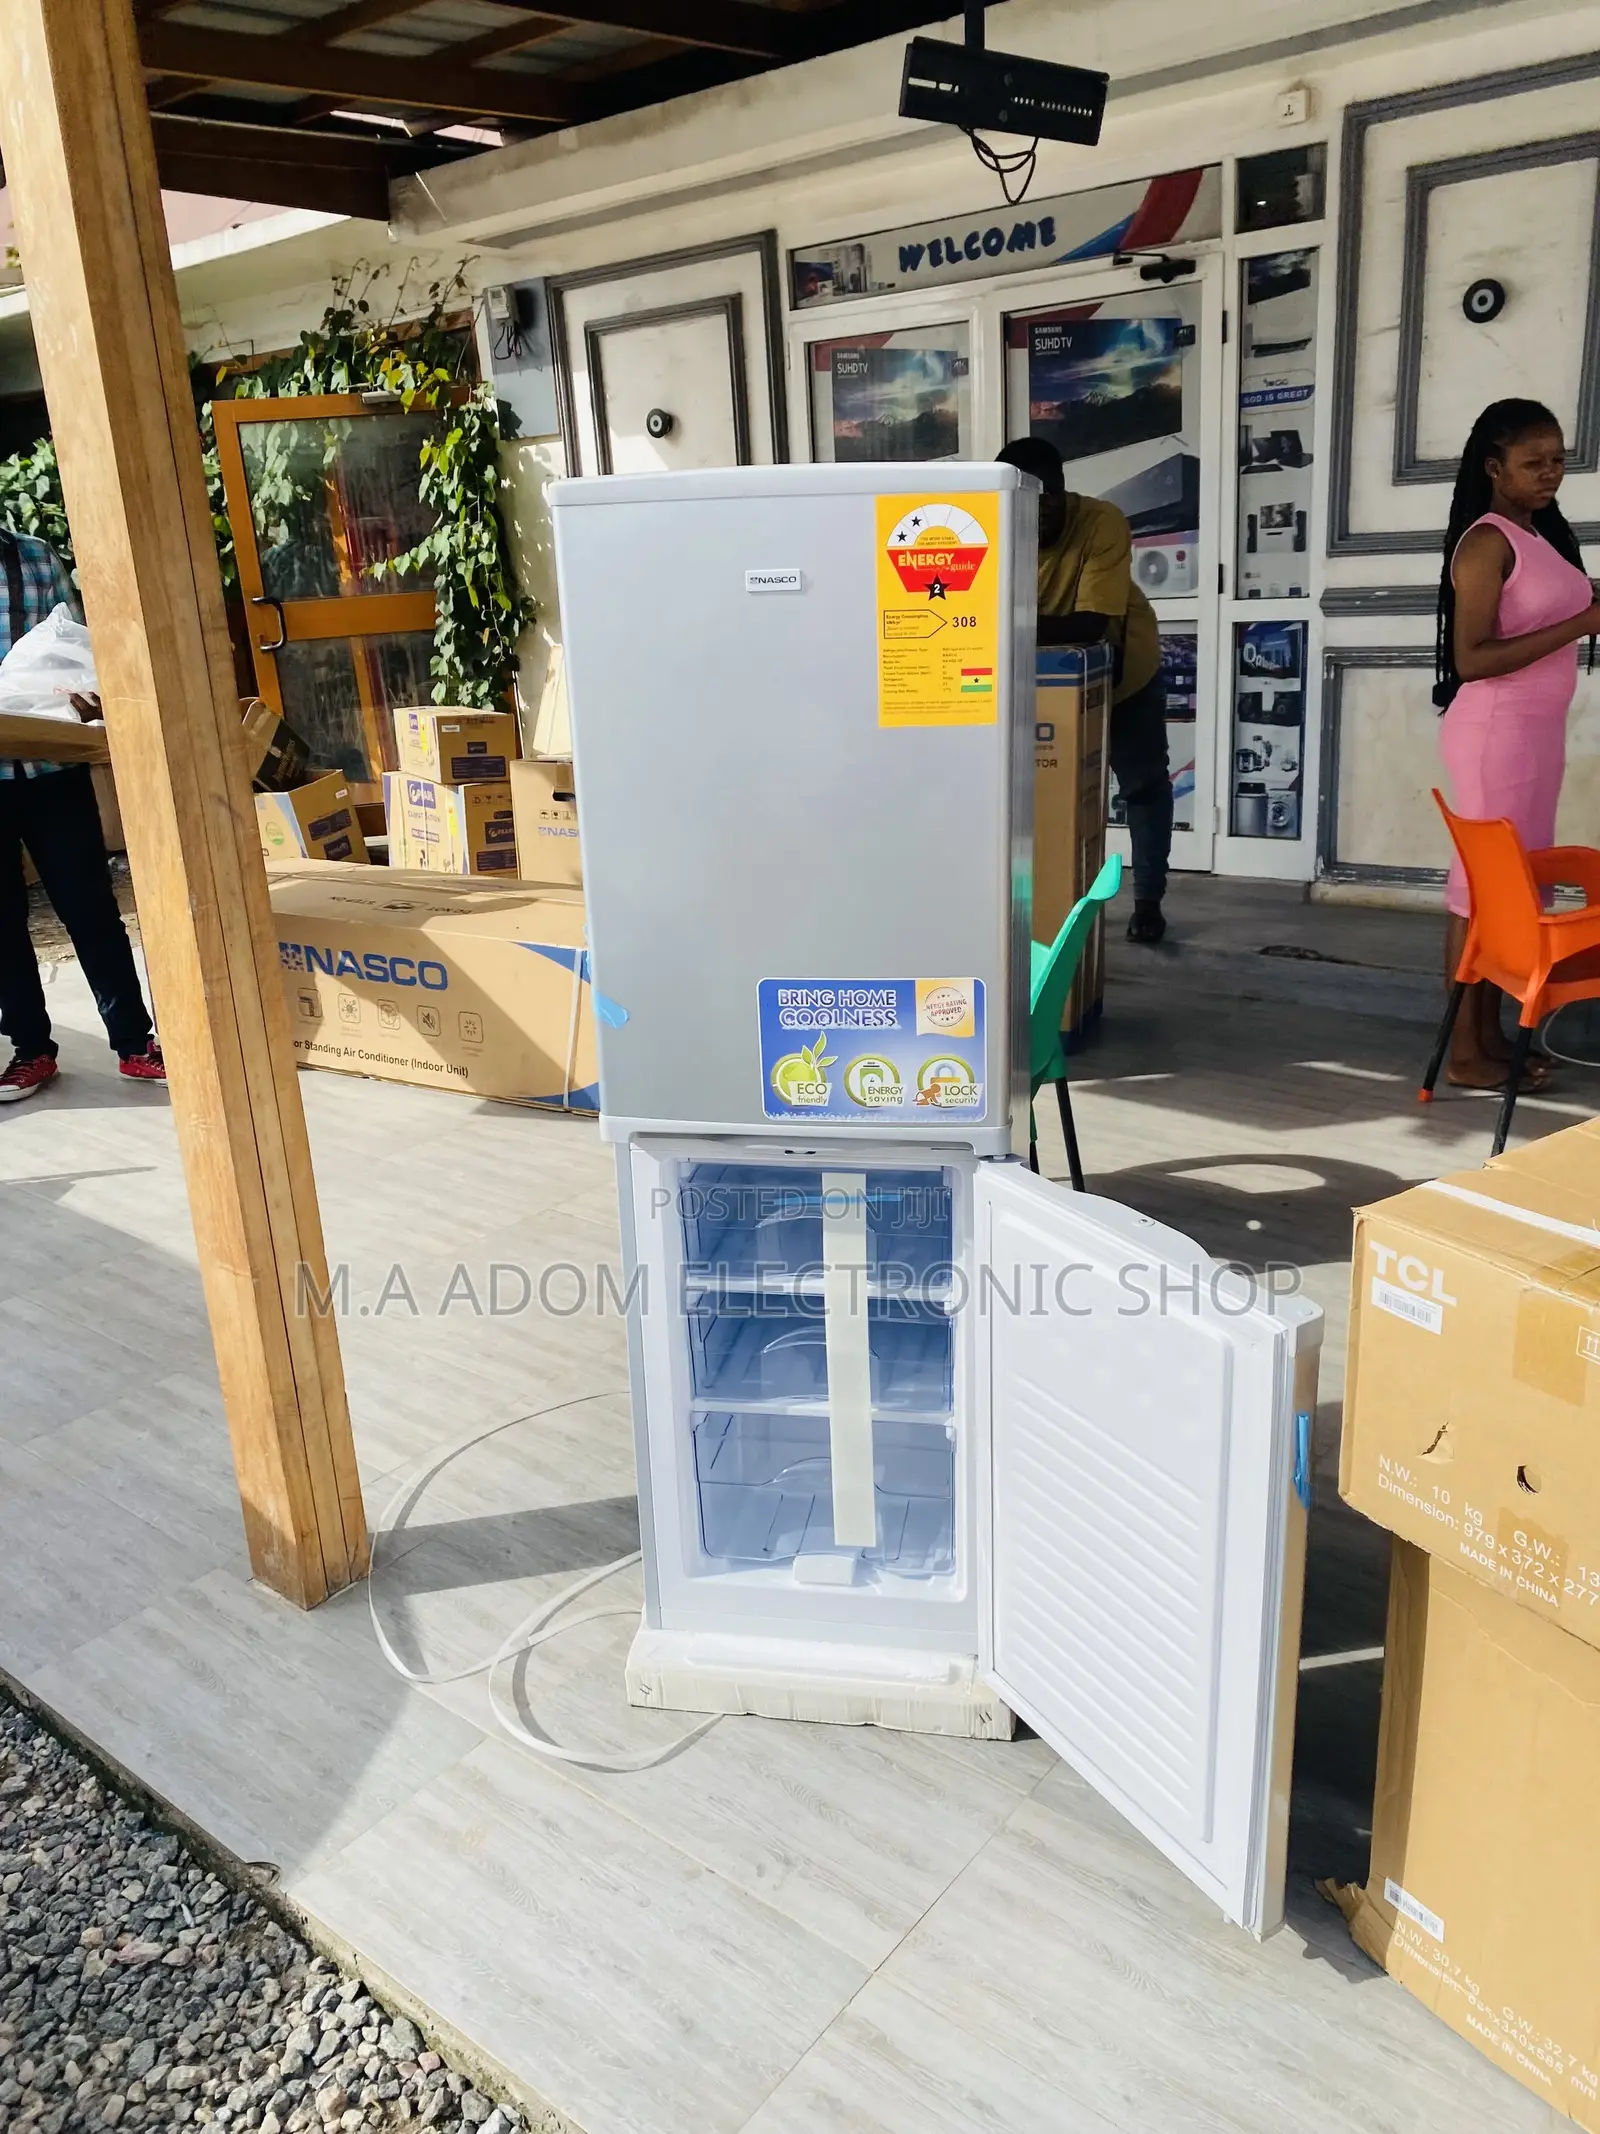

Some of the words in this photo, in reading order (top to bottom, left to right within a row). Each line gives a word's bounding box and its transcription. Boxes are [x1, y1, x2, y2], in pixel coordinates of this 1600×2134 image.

[898, 216, 1056, 272] WELCOME
[898, 550, 954, 571] ENERGY
[950, 560, 976, 572] guide
[758, 576, 797, 584] NASCO
[933, 584, 941, 594] 2
[952, 616, 977, 628] 308
[303, 945, 449, 991] NASCO
[778, 989, 835, 1007] BRING
[839, 989, 897, 1007] HOME
[780, 1008, 898, 1028] COOLNESS
[931, 1006, 962, 1017] APPROVED
[304, 1039, 342, 1058] Standing
[343, 1048, 356, 1058] Air
[358, 1049, 409, 1067] Conditioner
[411, 1057, 444, 1073] (Indoor
[446, 1063, 469, 1079] Unit)
[797, 1083, 827, 1095] ECO
[867, 1086, 903, 1095] ENERGY
[944, 1085, 978, 1096] LOCK
[797, 1096, 827, 1105] friendly
[868, 1095, 903, 1105] saving
[945, 1096, 978, 1105] security
[1369, 1240, 1457, 1308] TCL
[1379, 1454, 1418, 1488] N.W.:
[1432, 1485, 1451, 1505] 10
[1464, 1502, 1483, 1526] kg
[1513, 1530, 1560, 1567] G.W.:
[1378, 1473, 1459, 1531] Dimension:
[1463, 1523, 1495, 1550] 979
[1511, 1549, 1545, 1579] 372
[1563, 1578, 1599, 1608] 277
[1460, 1542, 1496, 1572] MADE
[1500, 1564, 1513, 1581] IN
[1516, 1575, 1559, 1608] CHINA
[1465, 1975, 1480, 1996] kg
[1582, 2064, 1598, 2088] kg
[1465, 2013, 1499, 2046] MADE
[1501, 2041, 1514, 2057] IN
